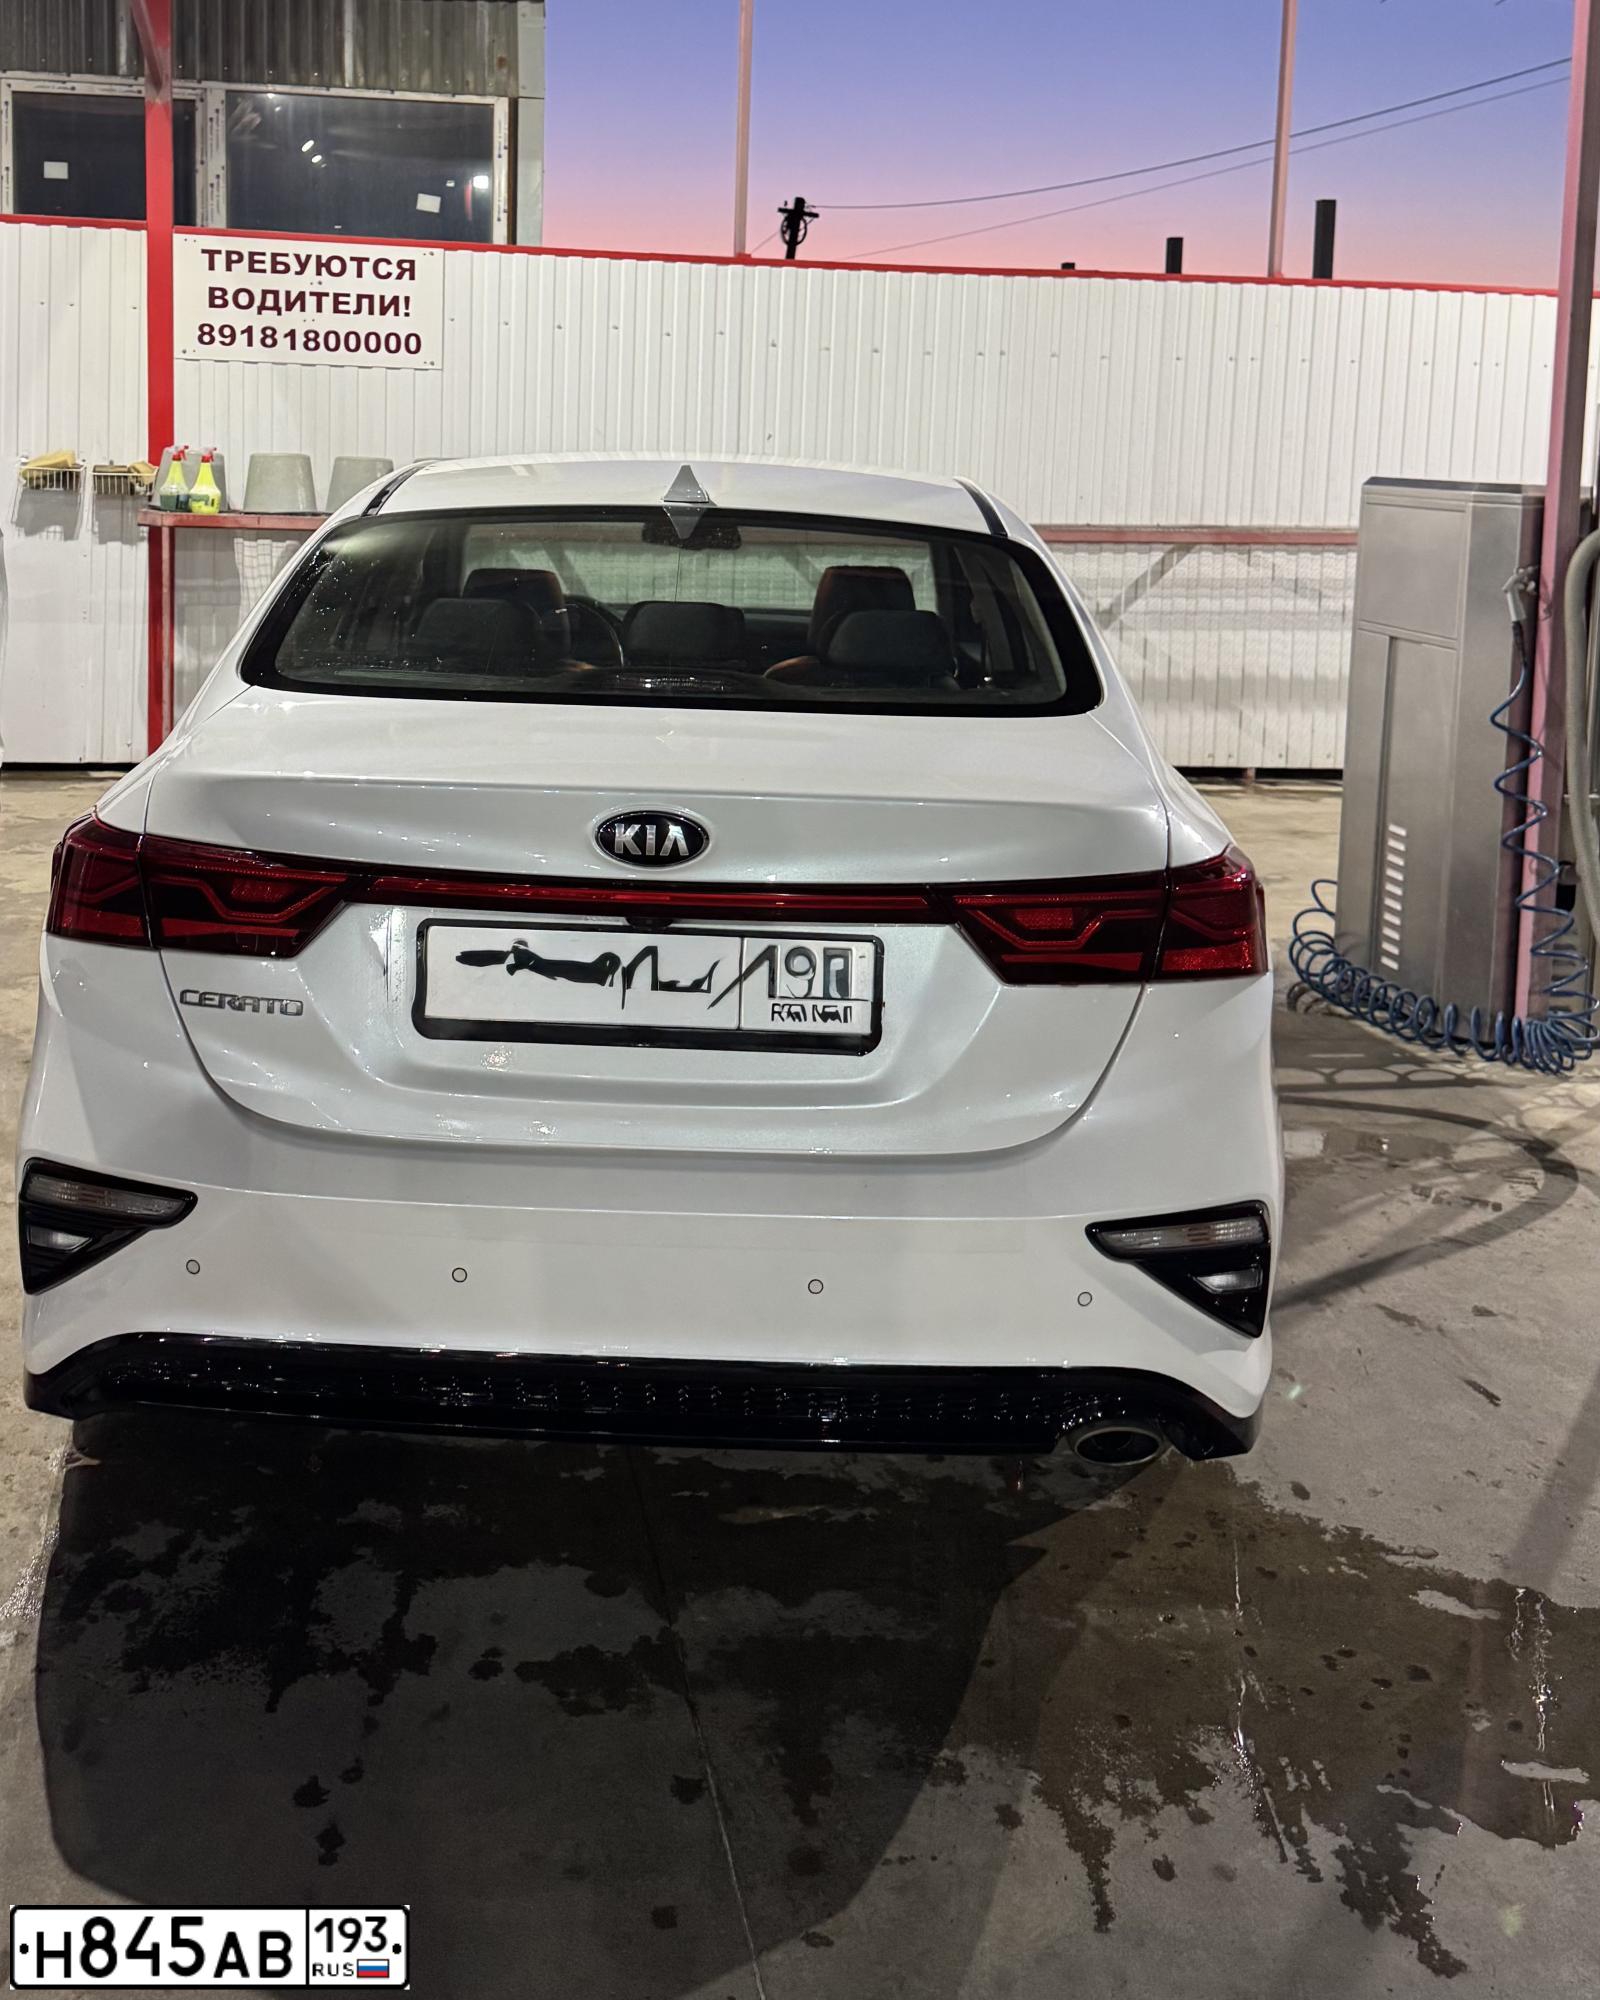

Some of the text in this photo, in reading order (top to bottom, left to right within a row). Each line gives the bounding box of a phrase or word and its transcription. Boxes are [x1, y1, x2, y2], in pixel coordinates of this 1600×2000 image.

[200, 248, 417, 281] ТРЕБУЮТСЯ
[207, 286, 412, 318] ВОДИТЕЛИ!
[197, 322, 423, 355] 89181800000
[614, 823, 689, 856] KIA
[180, 989, 304, 1016] CERATO
